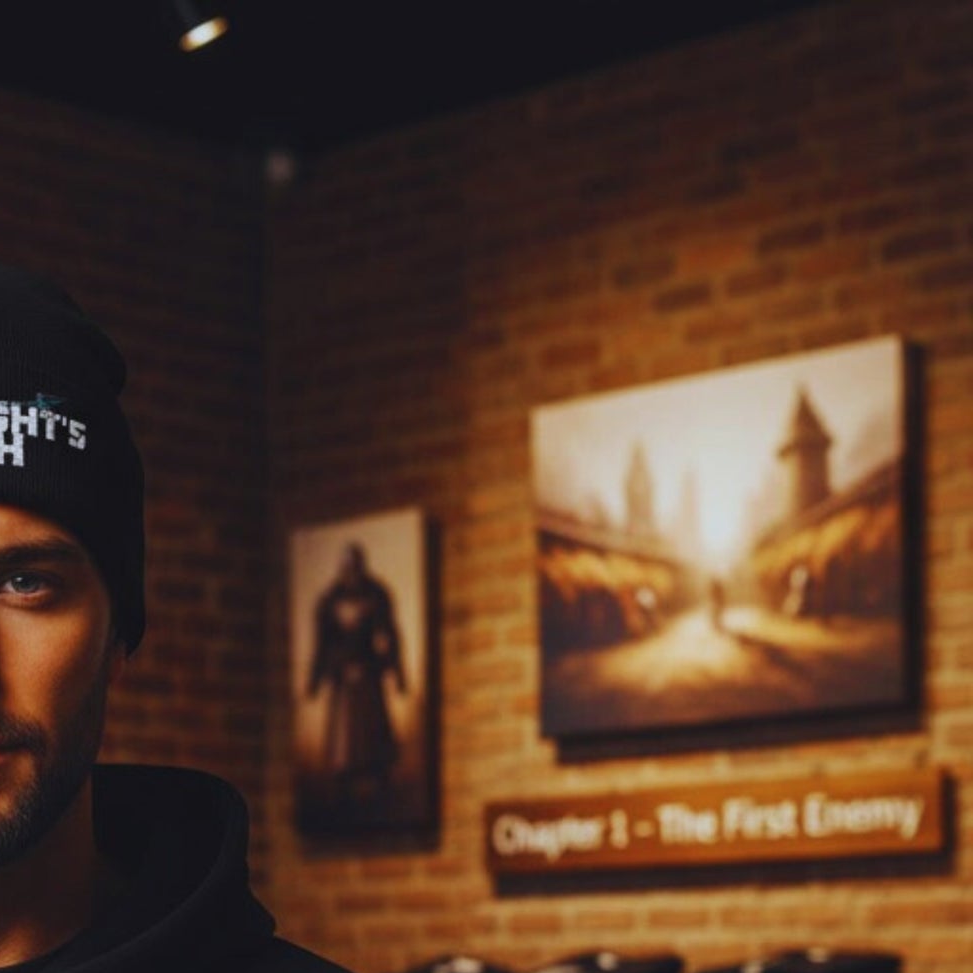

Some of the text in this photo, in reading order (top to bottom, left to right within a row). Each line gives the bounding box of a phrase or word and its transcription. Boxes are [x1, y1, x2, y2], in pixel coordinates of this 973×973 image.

[493, 814, 604, 862] Chapter
[656, 802, 718, 843] The
[722, 797, 797, 841] First
[804, 792, 924, 839] Enemy
